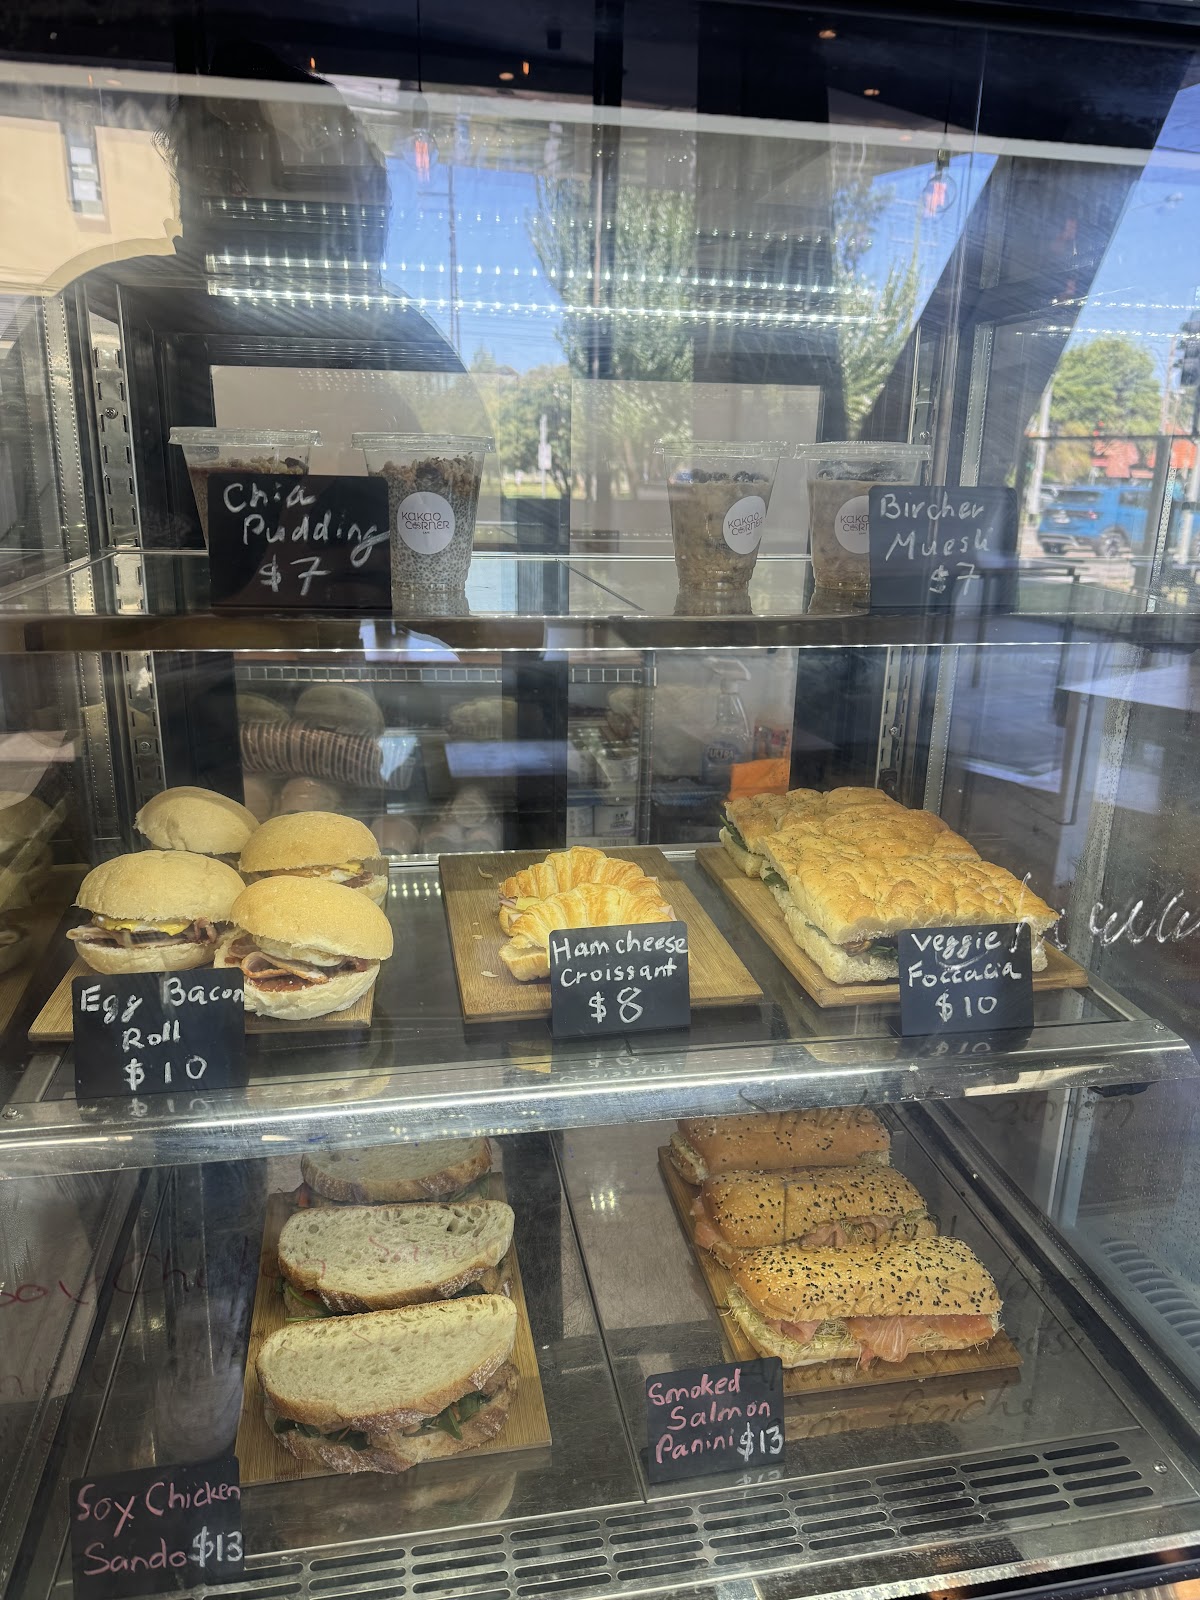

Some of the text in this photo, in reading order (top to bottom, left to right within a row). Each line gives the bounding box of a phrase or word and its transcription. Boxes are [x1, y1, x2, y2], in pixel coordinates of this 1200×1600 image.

[223, 482, 317, 513] Chia
[880, 491, 984, 520] Bircher
[243, 510, 390, 568] Pudding
[552, 930, 689, 965] Ham cheese
[911, 931, 1001, 959] Veggie
[560, 957, 678, 988] Croissant
[81, 976, 244, 1024] Egg Bacon
[588, 986, 644, 1024] $8
[935, 992, 998, 1022] $10
[122, 1019, 181, 1053] Roll
[648, 1368, 741, 1406] Smoked
[666, 1401, 771, 1431] Salmon
[655, 1428, 734, 1464] Panini
[737, 1421, 784, 1462] $13
[77, 1482, 241, 1537] Soy Chicken
[84, 1525, 243, 1576] Sando $13
